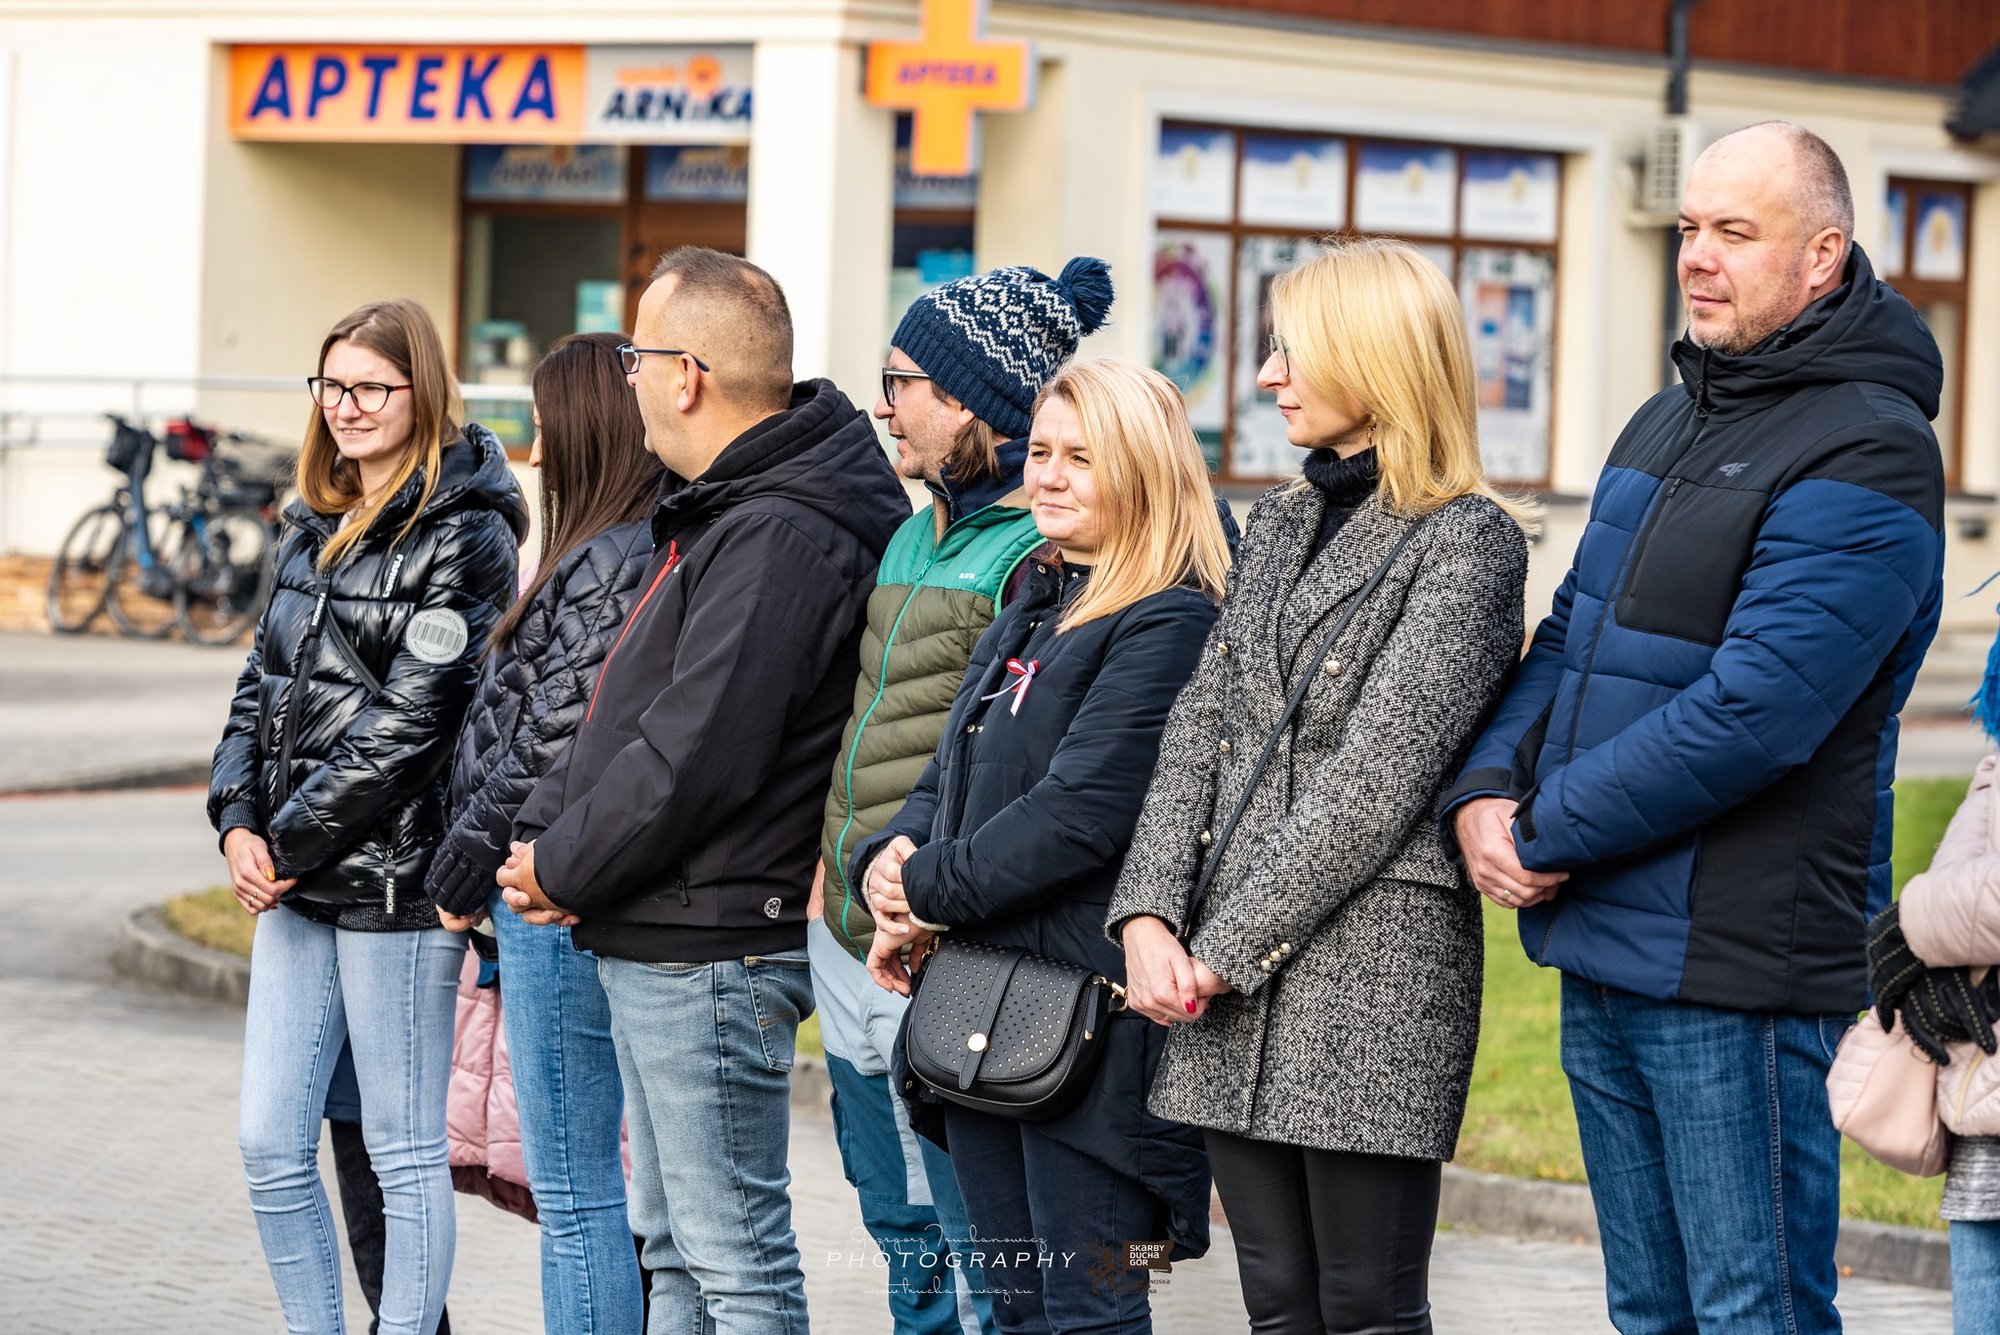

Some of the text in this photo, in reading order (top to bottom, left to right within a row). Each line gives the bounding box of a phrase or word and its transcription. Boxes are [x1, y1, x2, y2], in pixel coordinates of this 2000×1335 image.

[248, 57, 556, 119] APTEKA
[898, 62, 997, 84] APTEKA
[386, 878, 394, 914] FASHION
